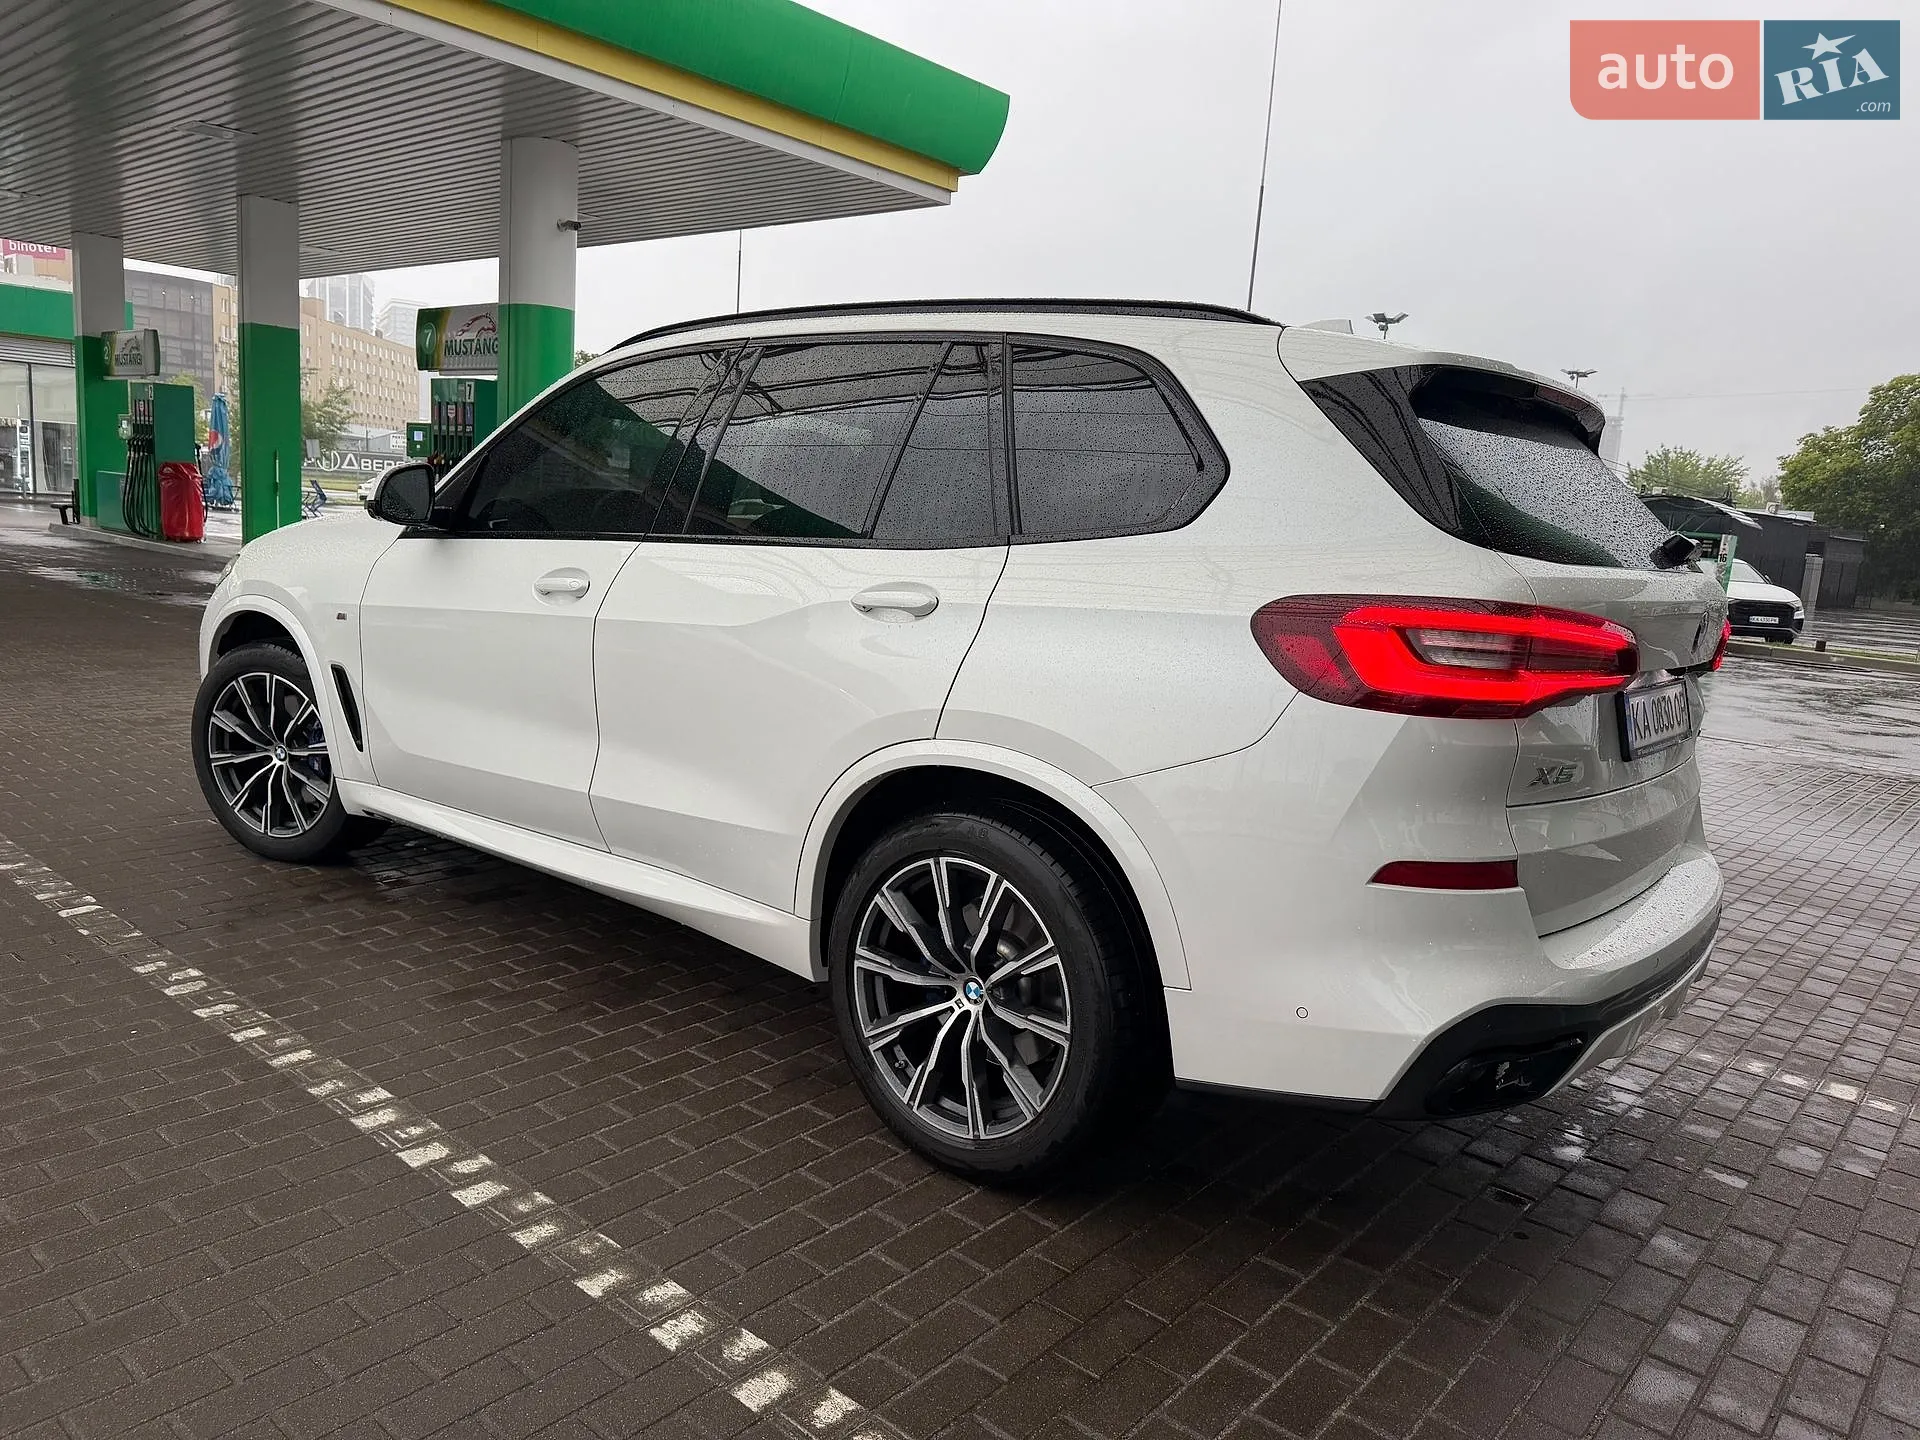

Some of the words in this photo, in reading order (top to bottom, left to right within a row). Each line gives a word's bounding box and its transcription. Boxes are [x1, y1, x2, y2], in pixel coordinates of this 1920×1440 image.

[424, 329, 432, 348] 7
[444, 337, 498, 356] MUSTANG
[103, 346, 109, 360] 2
[466, 383, 473, 400] 7
[1631, 700, 1652, 742] KA
[1651, 694, 1675, 735] 0830
[1527, 763, 1577, 786] X5
